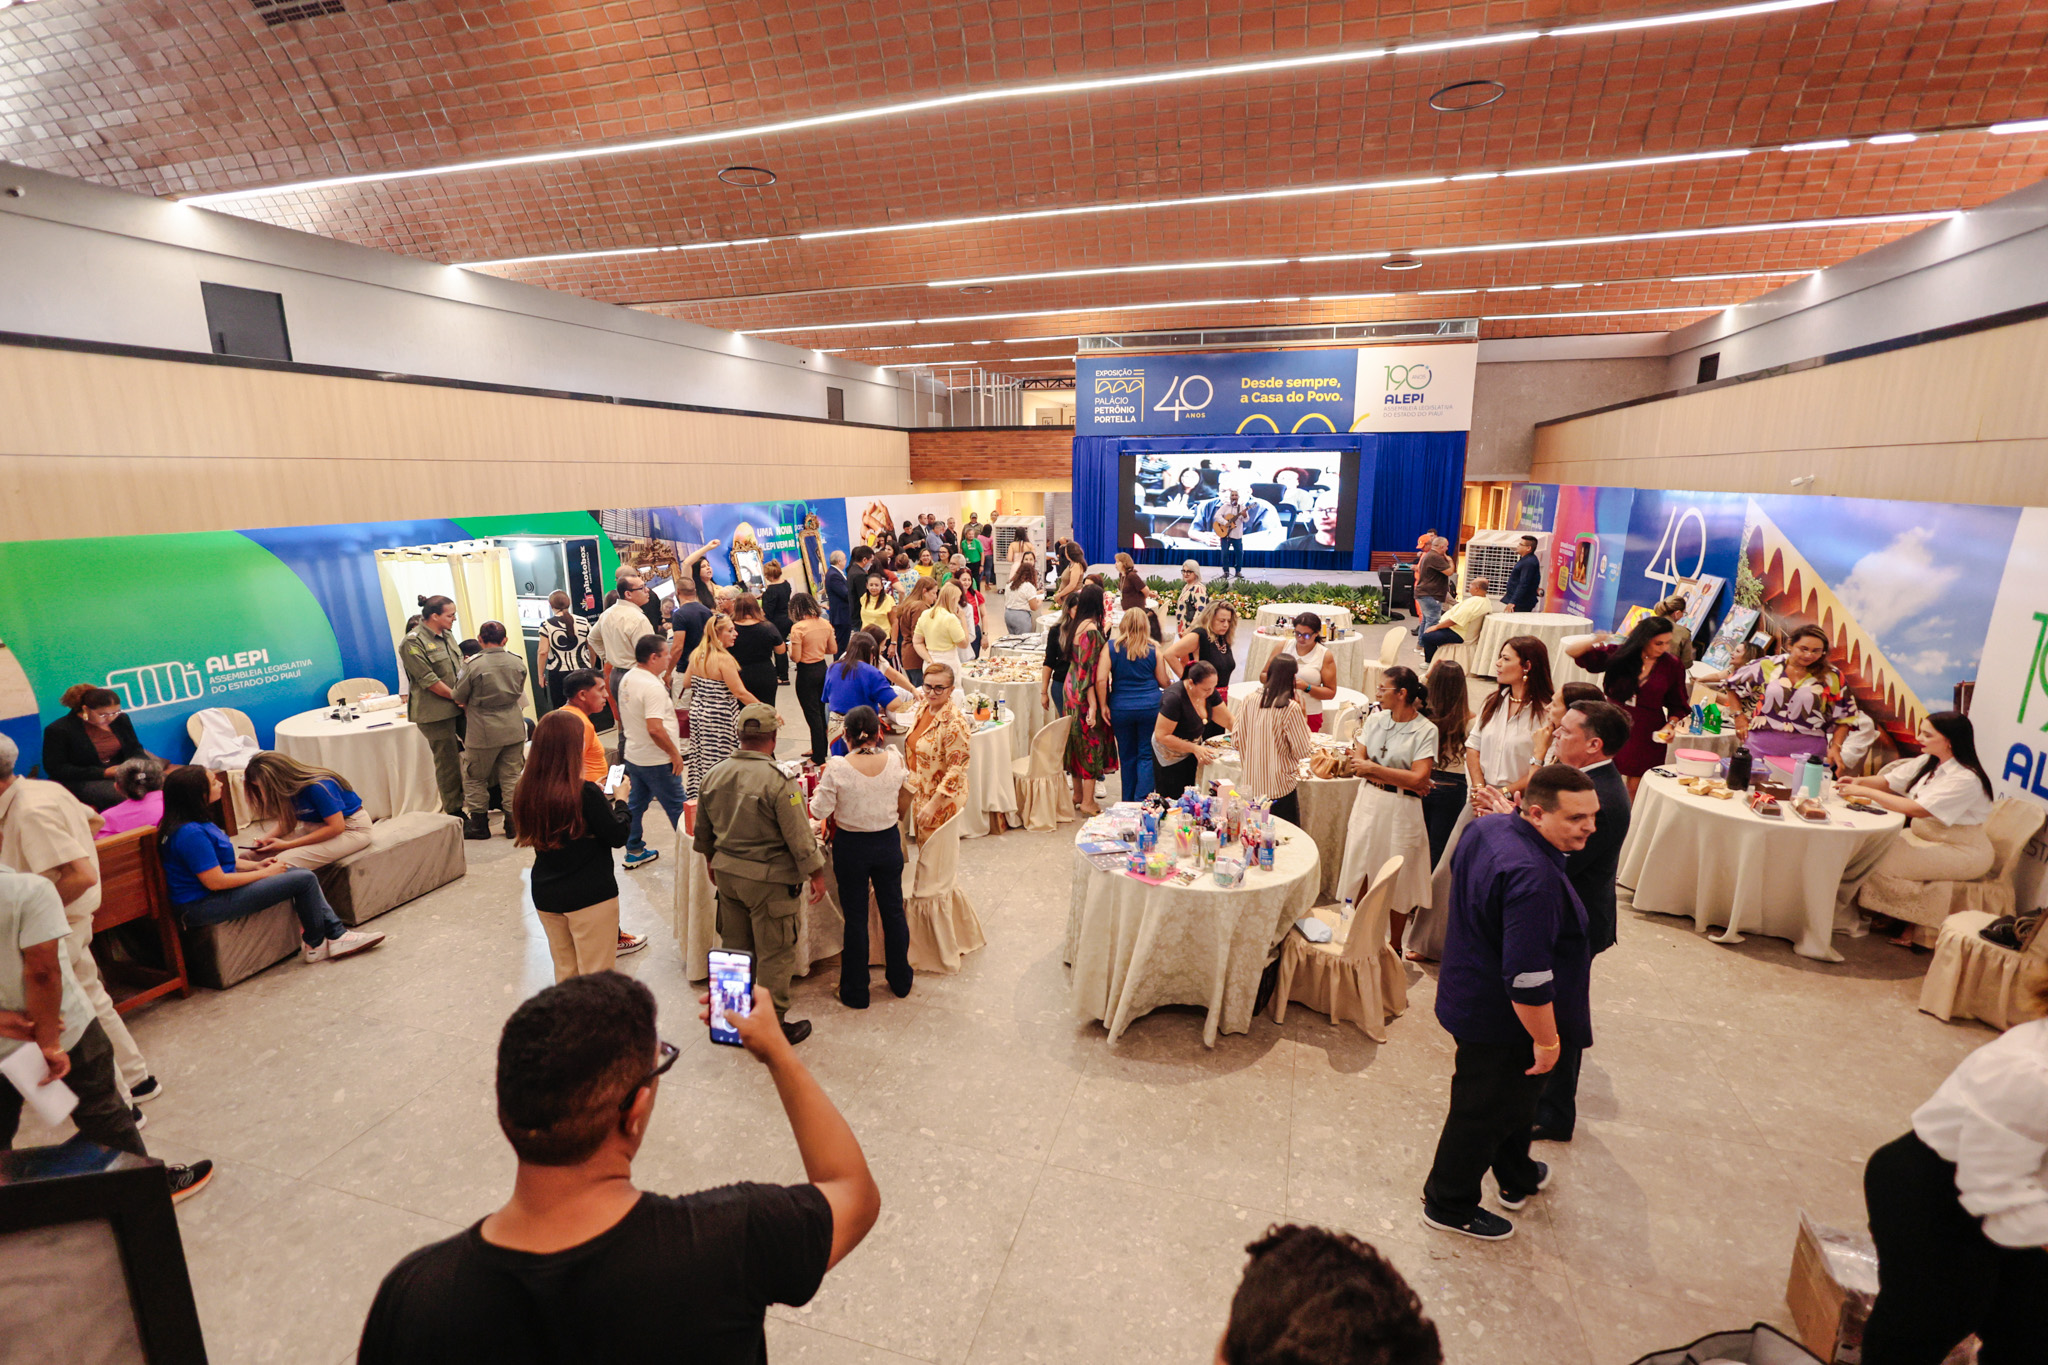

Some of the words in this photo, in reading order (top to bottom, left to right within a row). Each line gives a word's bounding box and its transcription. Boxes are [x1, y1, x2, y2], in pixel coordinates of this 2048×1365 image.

[1095, 368, 1133, 377] EXPOSIÇÃO
[1384, 363, 1432, 391] 190
[1241, 377, 1284, 389] Desde
[1285, 377, 1341, 390] sempre,
[1094, 395, 1129, 405] PALÁCIO
[1153, 374, 1214, 422] 40
[1240, 394, 1249, 403] a
[1251, 391, 1284, 403] Casa
[1286, 390, 1305, 403] do
[1307, 390, 1343, 402] Povo.
[1384, 393, 1425, 405] ALEPI
[1094, 405, 1136, 415] PETRÔNIO
[1094, 415, 1137, 424] PORTELLA
[756, 527, 774, 538] UMA
[775, 525, 794, 536] NOVA
[775, 540, 788, 550] VEM
[1644, 505, 1707, 602] 40
[580, 545, 592, 594] photobox
[205, 648, 270, 674] ALEPI
[209, 667, 263, 685] ASSEMBLEIA
[263, 658, 313, 674] LEGISLATIVA
[211, 684, 227, 694] DO
[228, 678, 263, 691] ESTADO
[265, 674, 279, 684] DO
[280, 669, 302, 681] PIAUÍ
